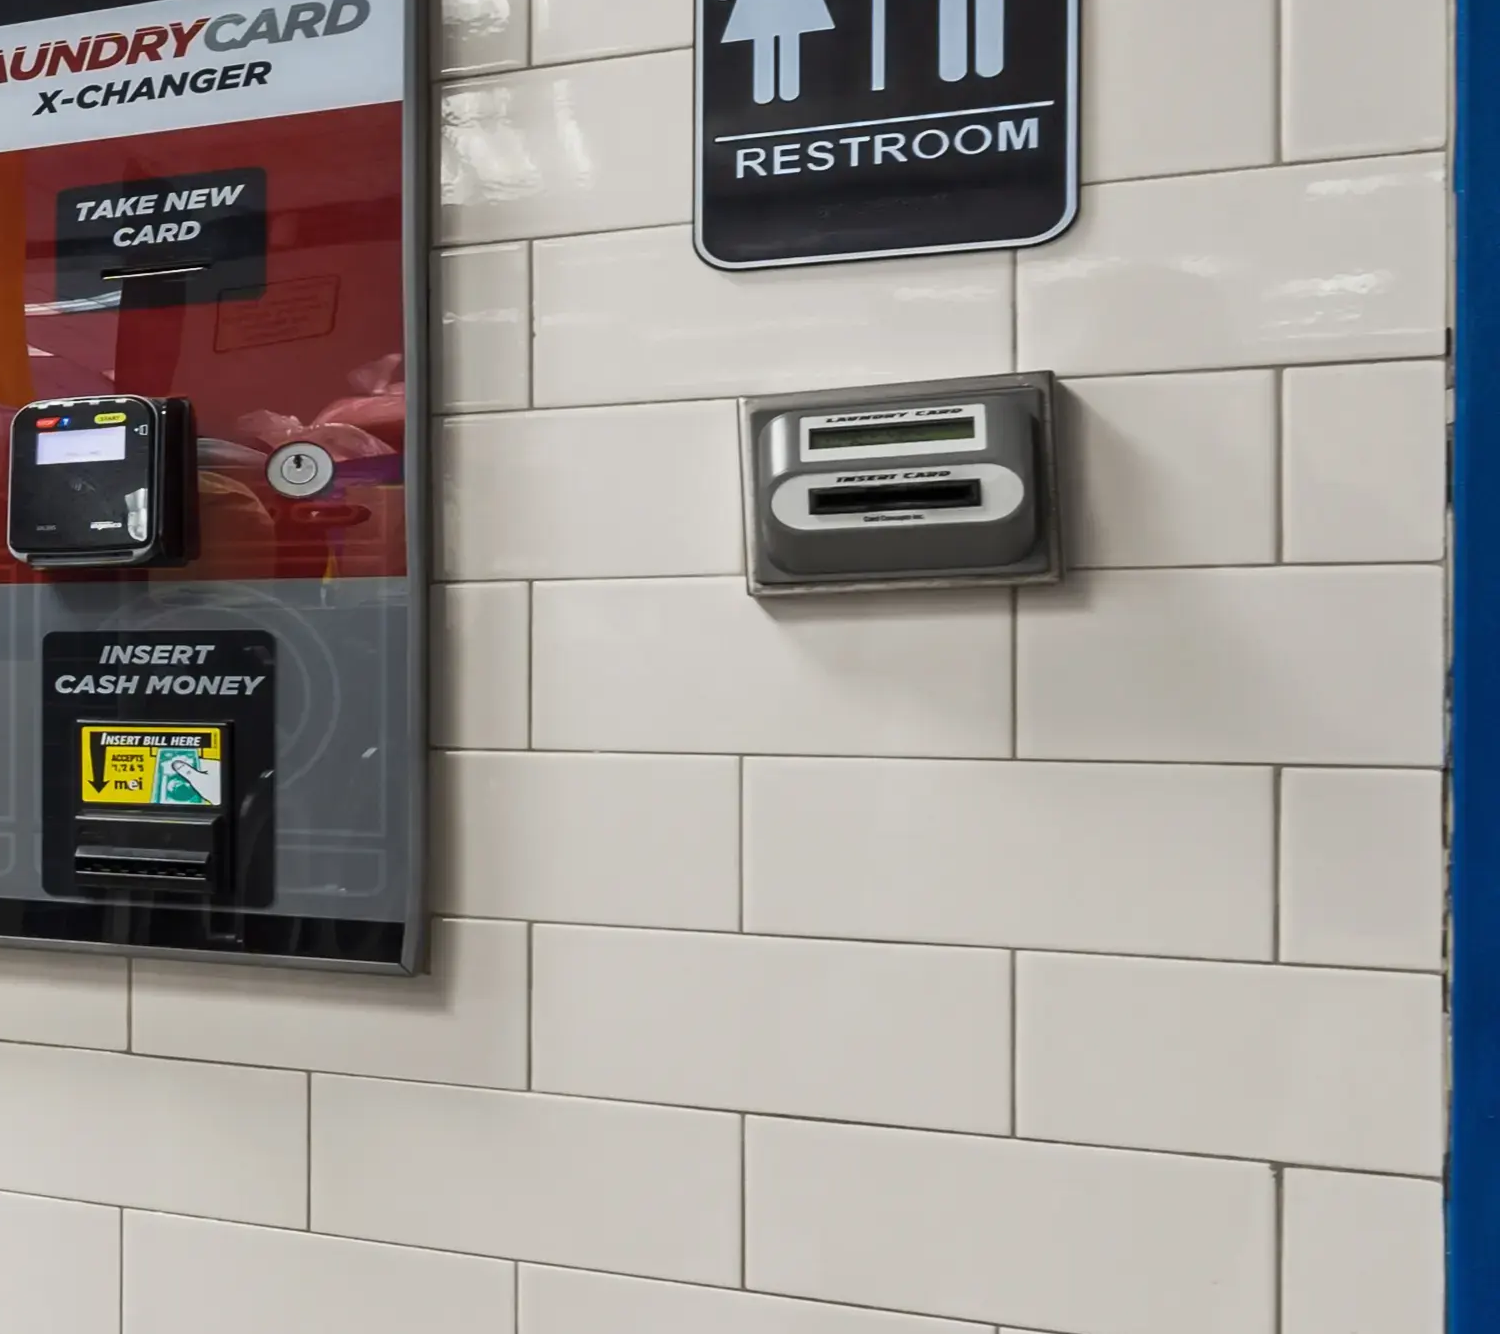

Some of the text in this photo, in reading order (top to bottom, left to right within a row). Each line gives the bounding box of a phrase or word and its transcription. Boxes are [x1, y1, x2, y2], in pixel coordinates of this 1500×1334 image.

[32, 60, 273, 117] X-CHANGER
[735, 117, 1040, 179] RESTROOM
[75, 184, 245, 223] TAKE NEW
[112, 220, 202, 249] CARD
[825, 407, 964, 423] LAUNDRY CARD
[836, 470, 952, 483] INSERT CARD
[99, 645, 215, 665] INSERT
[54, 674, 266, 696] CASH MONEY
[142, 735, 168, 747] BILL
[169, 736, 201, 748] HERE
[114, 777, 143, 791] mei
